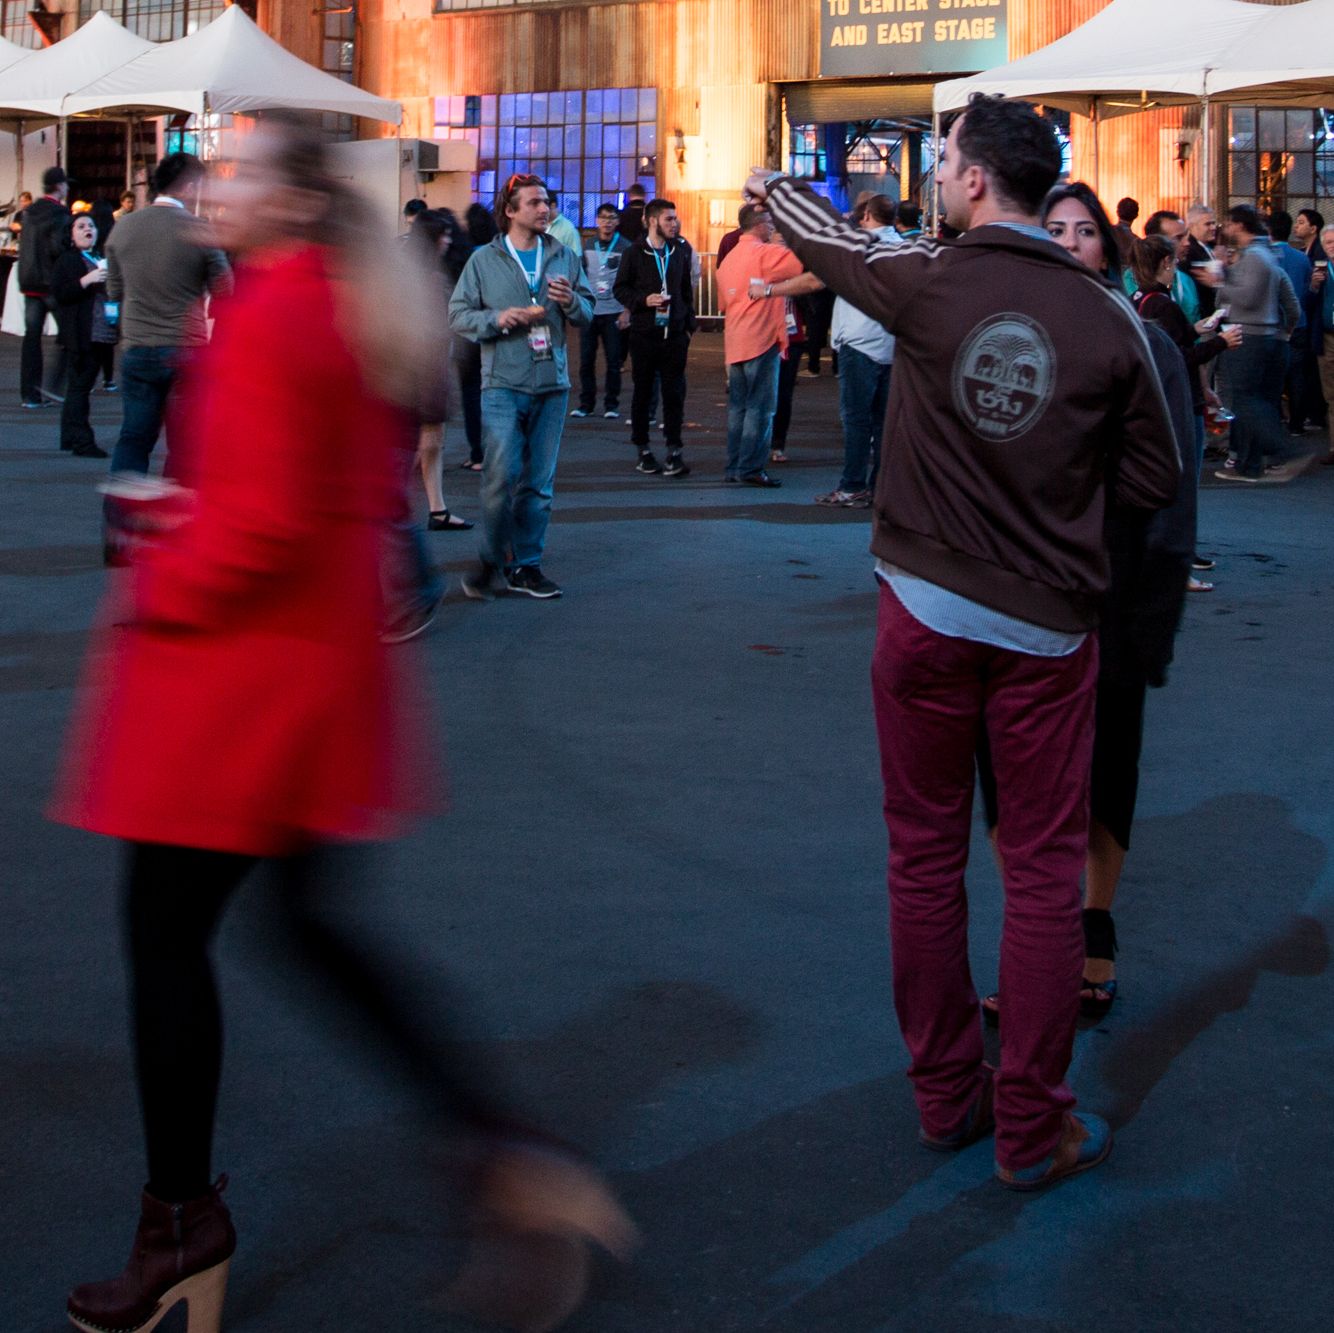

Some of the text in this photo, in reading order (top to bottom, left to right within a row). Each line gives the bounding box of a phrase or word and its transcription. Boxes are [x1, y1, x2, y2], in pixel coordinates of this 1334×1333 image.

[830, 17, 996, 47] AND EAST STAGE
